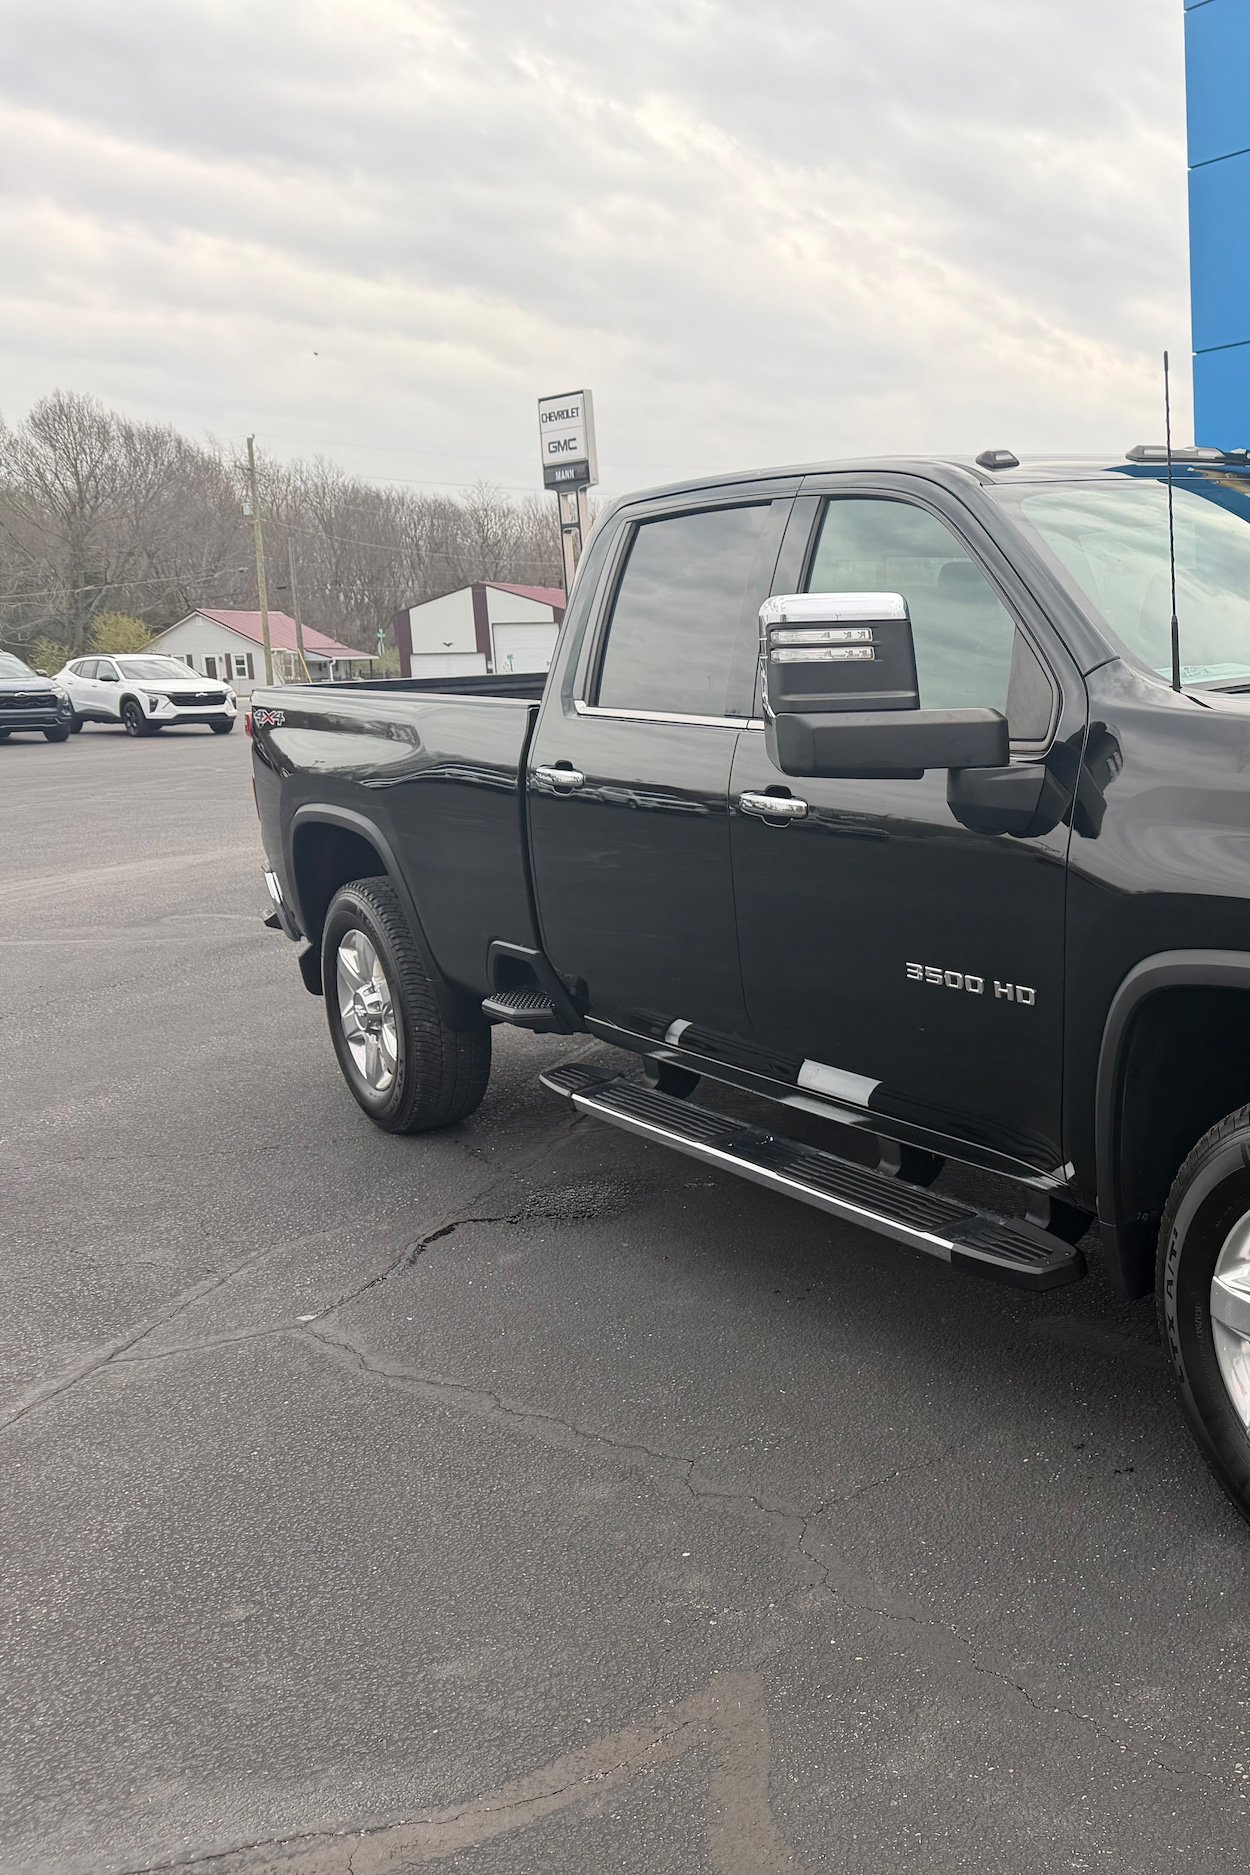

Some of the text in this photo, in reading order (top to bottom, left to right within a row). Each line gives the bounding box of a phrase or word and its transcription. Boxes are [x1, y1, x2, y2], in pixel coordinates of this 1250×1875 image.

[541, 407, 580, 423] CHEVROLET
[548, 438, 577, 454] GMC
[555, 468, 575, 480] MANN
[905, 961, 1037, 1006] 3500 HD
[1167, 1315, 1185, 1384] LTX
